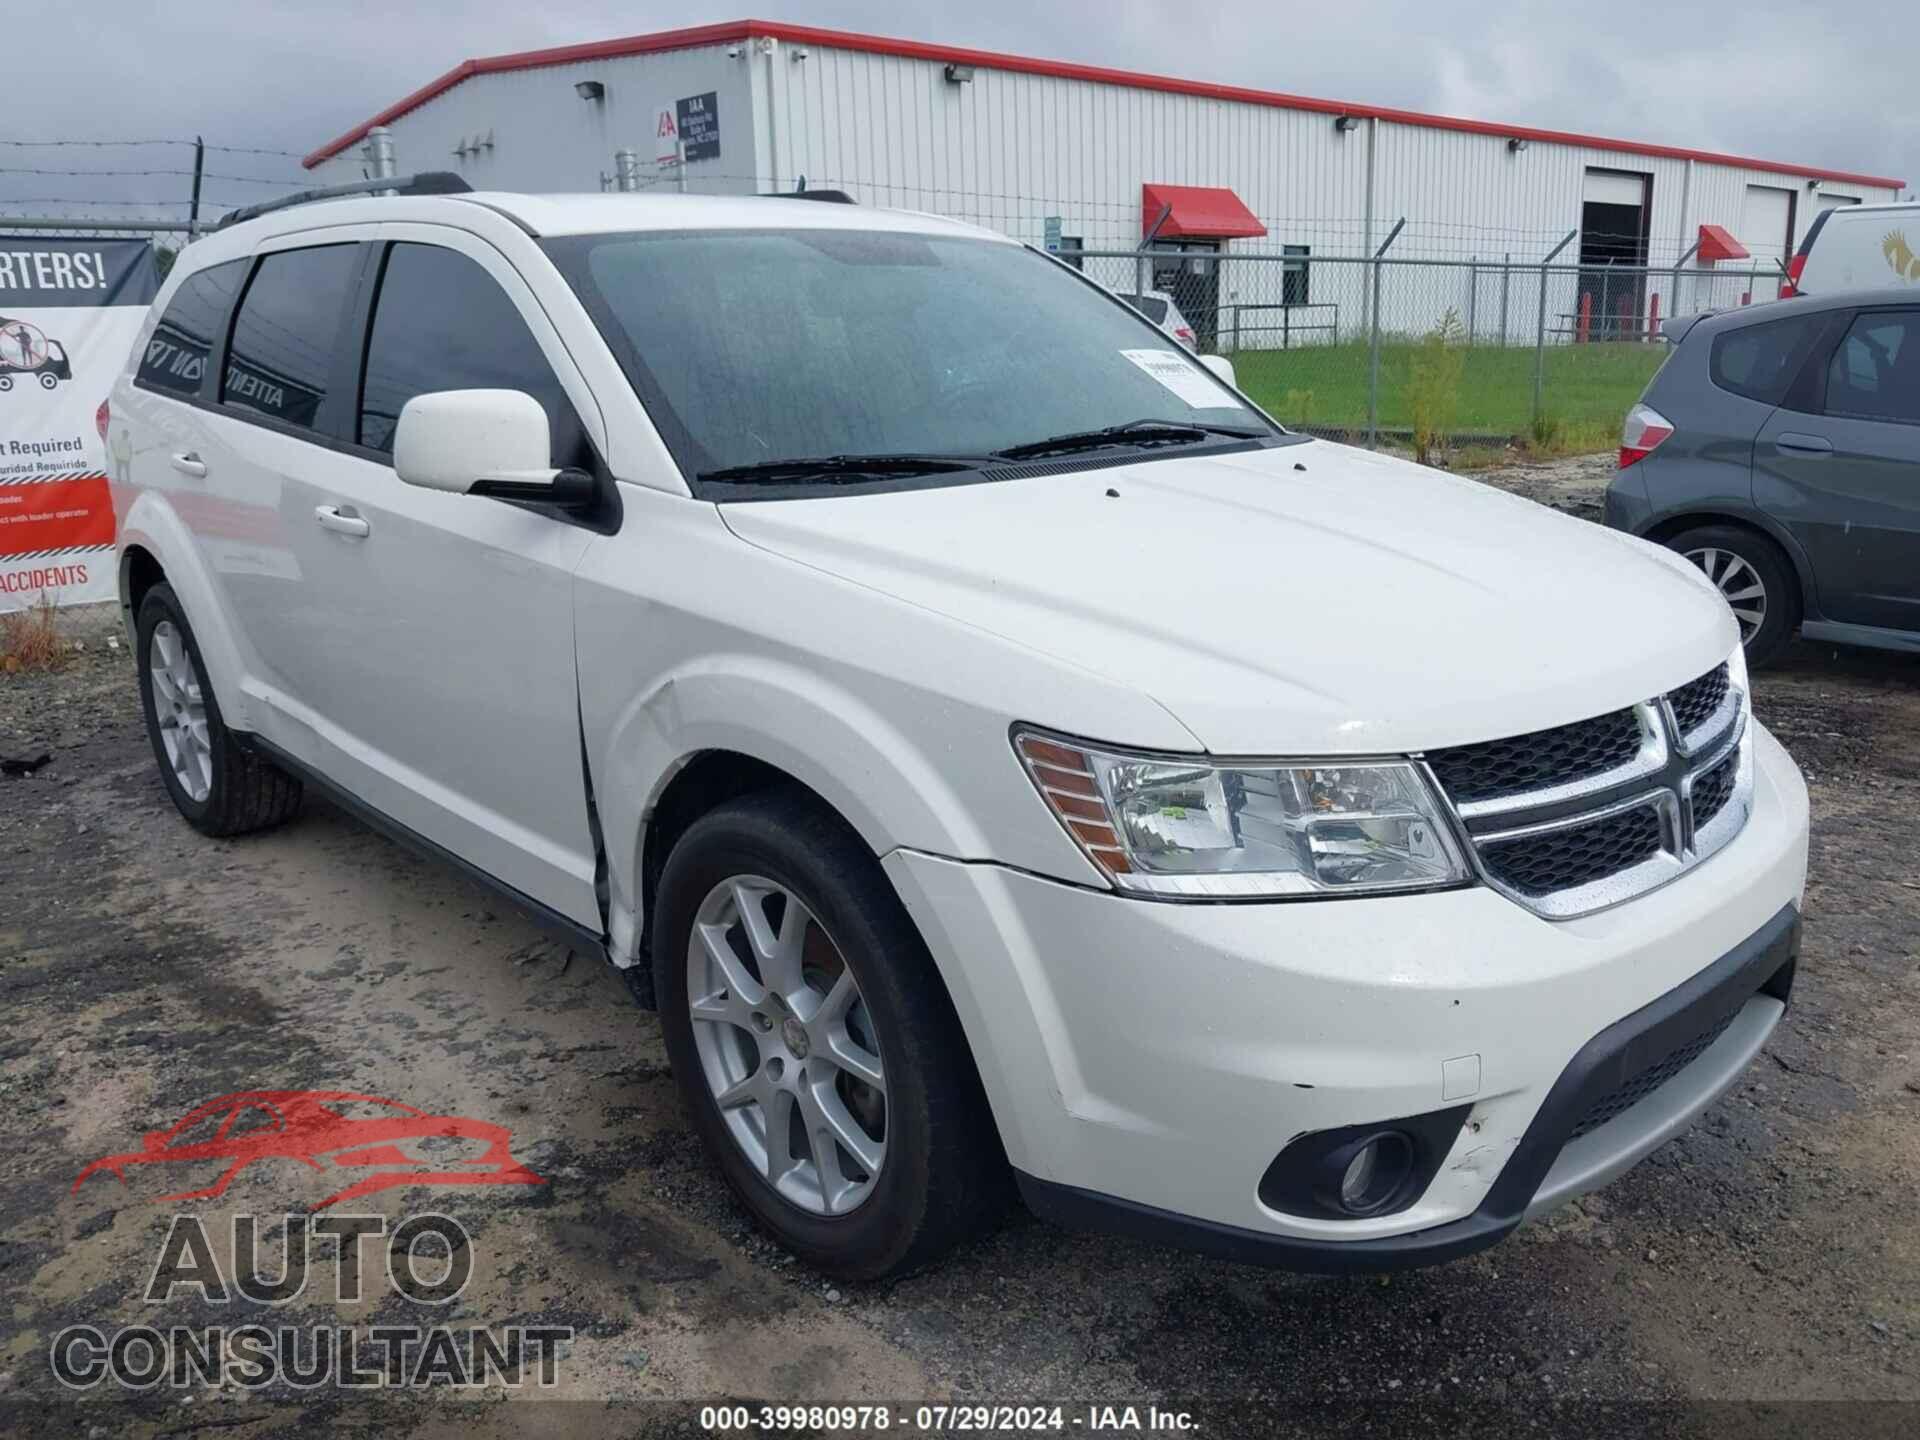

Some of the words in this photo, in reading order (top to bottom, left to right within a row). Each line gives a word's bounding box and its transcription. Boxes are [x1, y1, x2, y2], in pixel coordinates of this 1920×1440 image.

[10, 436, 83, 457] Required
[36, 460, 88, 473] Requirido
[0, 565, 88, 593] ACCIDENTS
